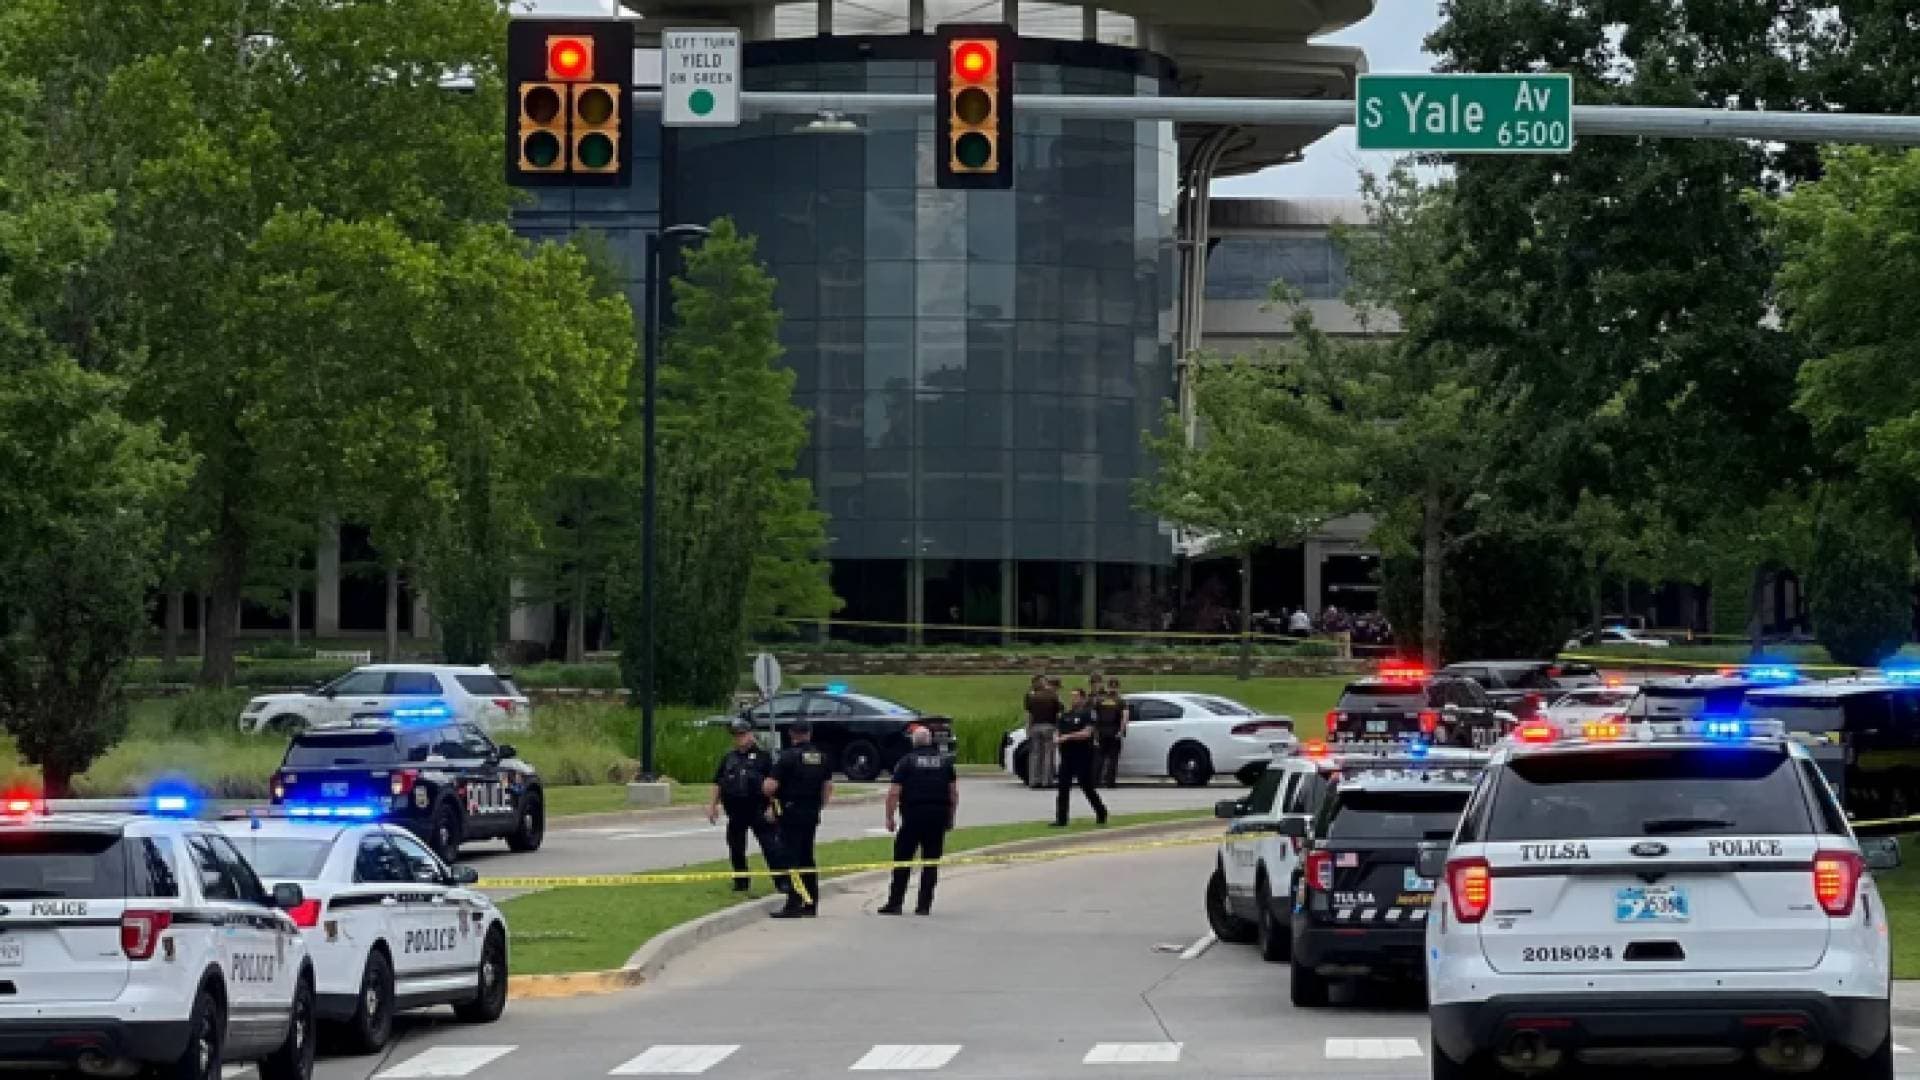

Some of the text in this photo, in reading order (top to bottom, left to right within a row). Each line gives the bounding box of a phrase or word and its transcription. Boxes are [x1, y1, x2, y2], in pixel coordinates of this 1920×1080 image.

[669, 37, 735, 49] LEFT TURN
[681, 53, 722, 68] YIELD
[670, 72, 733, 84] ON GREEN
[1364, 80, 1551, 133] S Yale Av
[1499, 121, 1565, 146] 6500
[466, 782, 513, 816] POLICE
[1520, 840, 1784, 861] TULSA POLICE
[1333, 891, 1376, 903] TULSA
[30, 902, 88, 916] POLICE
[404, 927, 458, 954] POLICE
[1522, 945, 1613, 962] 2018024
[231, 953, 275, 983] POLICE
